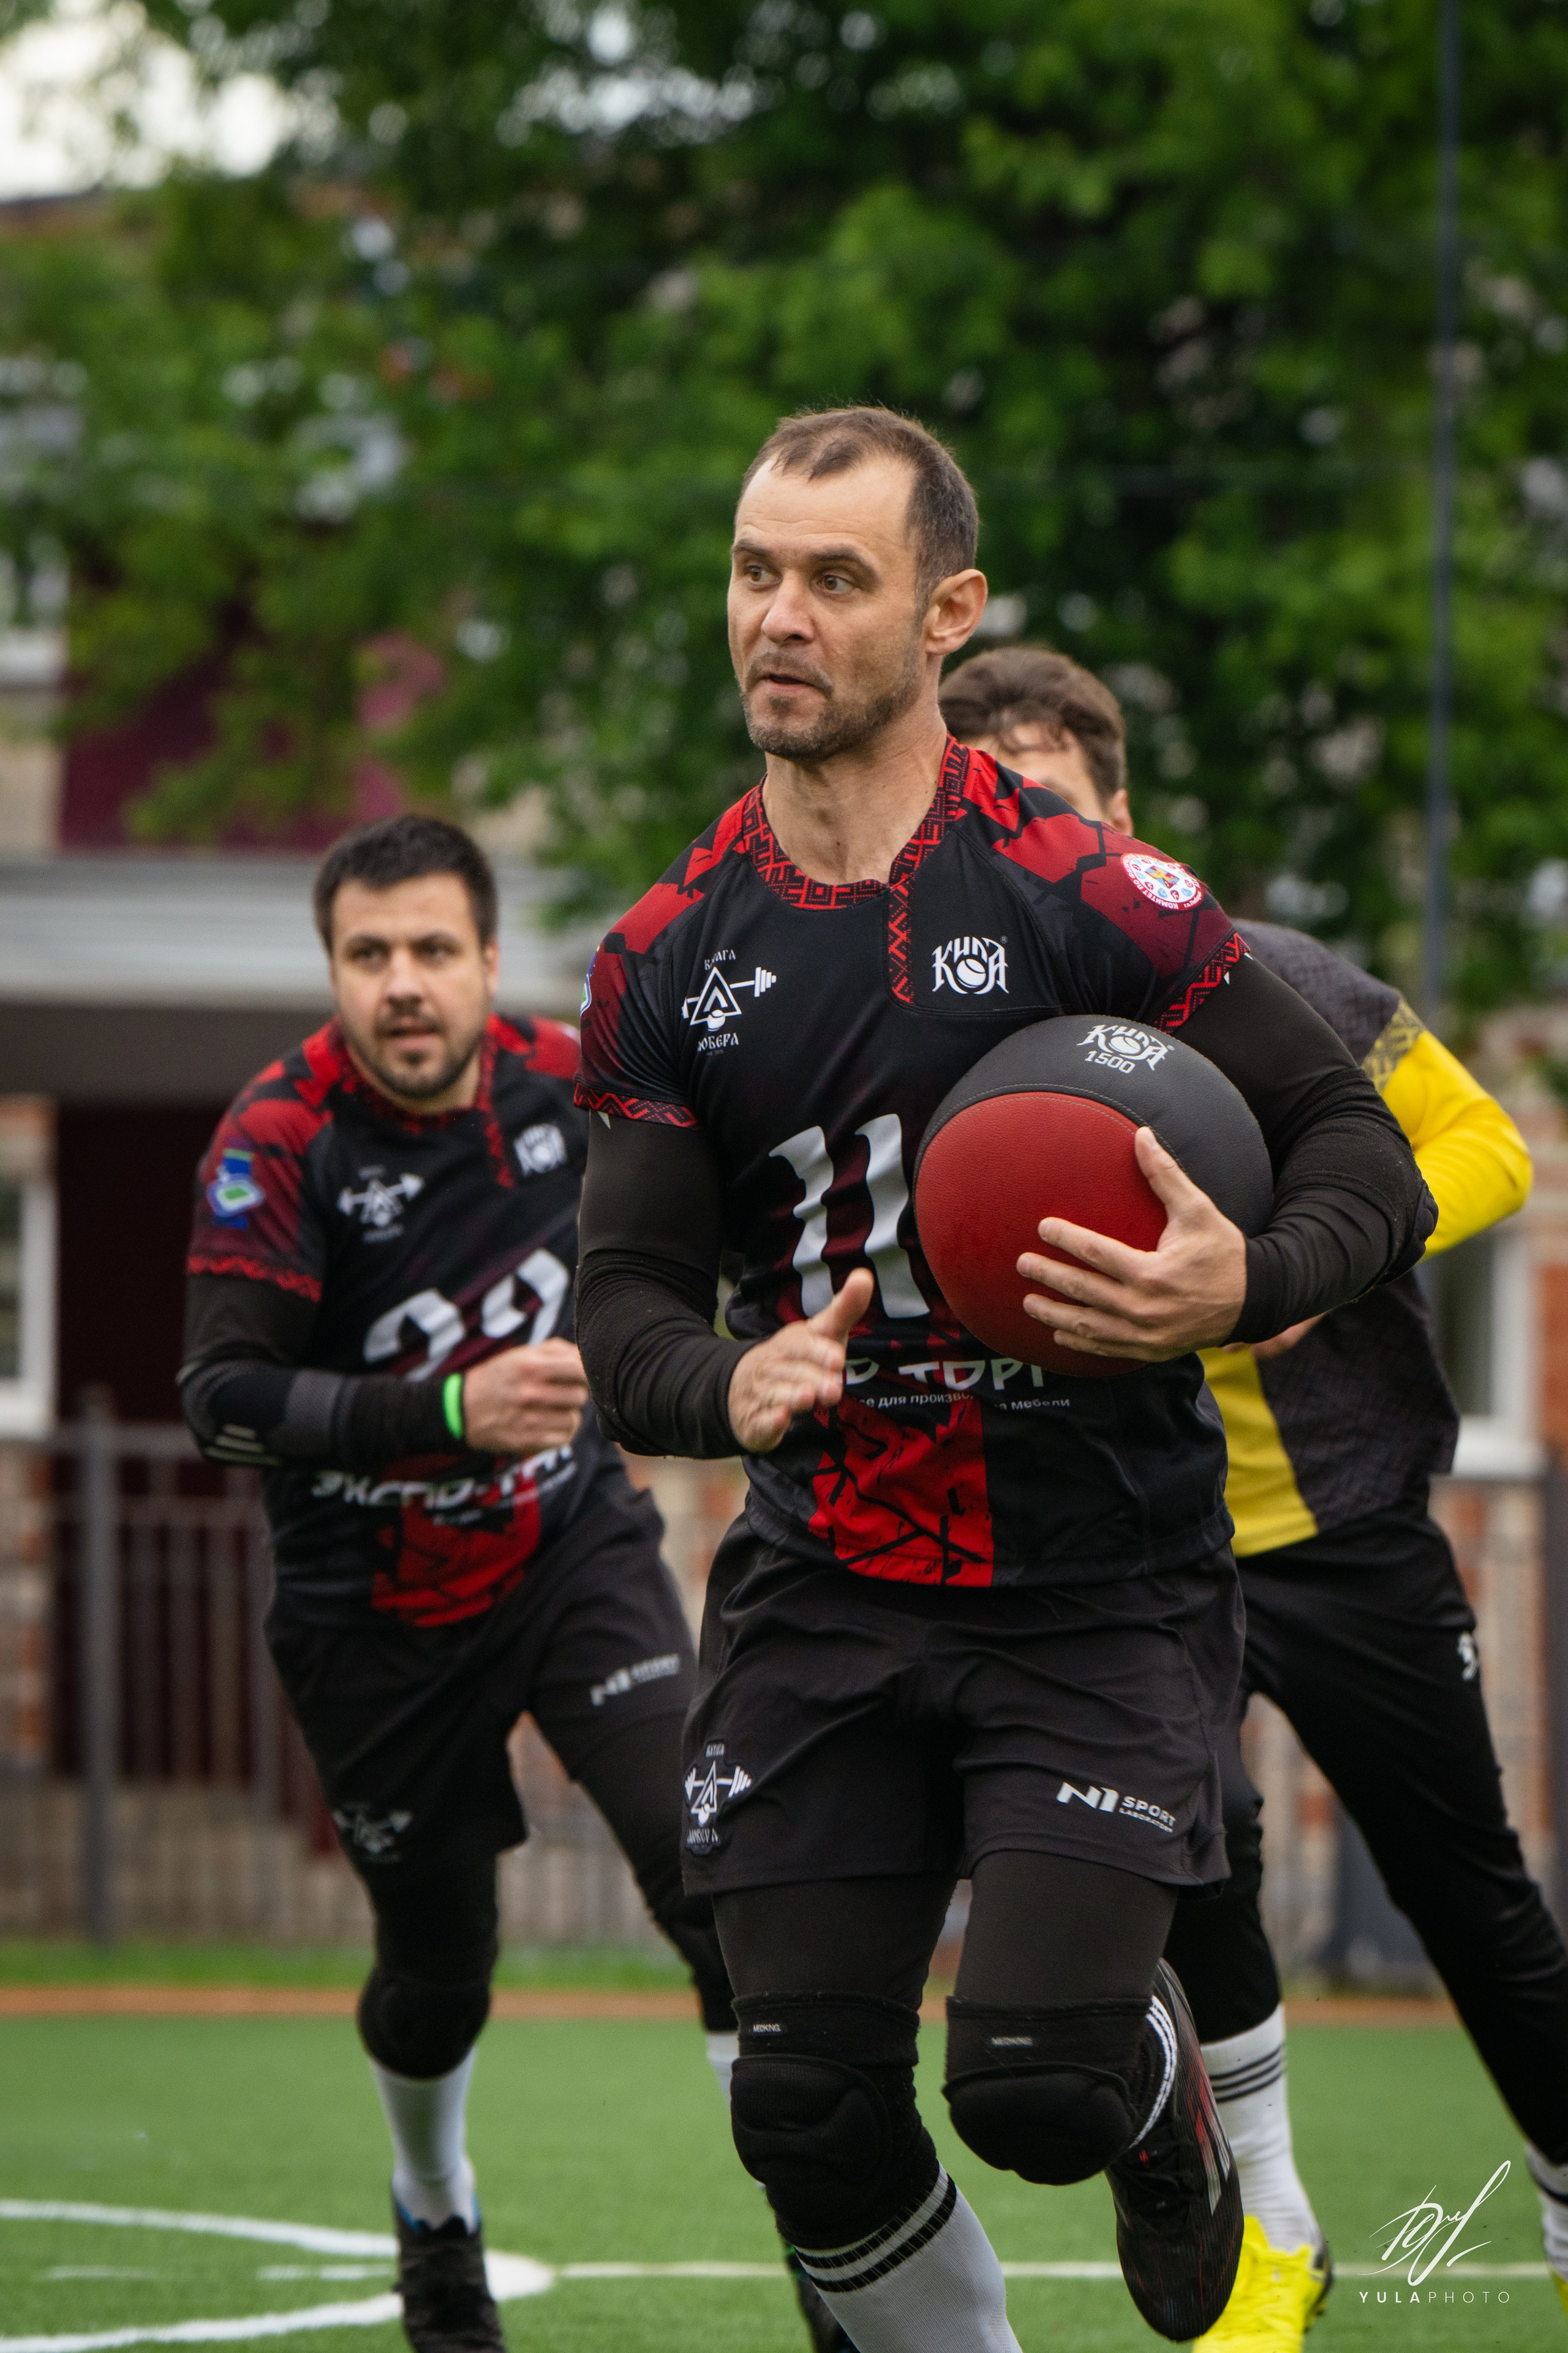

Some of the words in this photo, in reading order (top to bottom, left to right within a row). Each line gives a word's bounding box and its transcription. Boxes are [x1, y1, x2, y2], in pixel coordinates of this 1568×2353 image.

[1084, 1050, 1136, 1073] 1500
[768, 1112, 930, 1318] 11
[1121, 1796, 1177, 1827] SPORT
